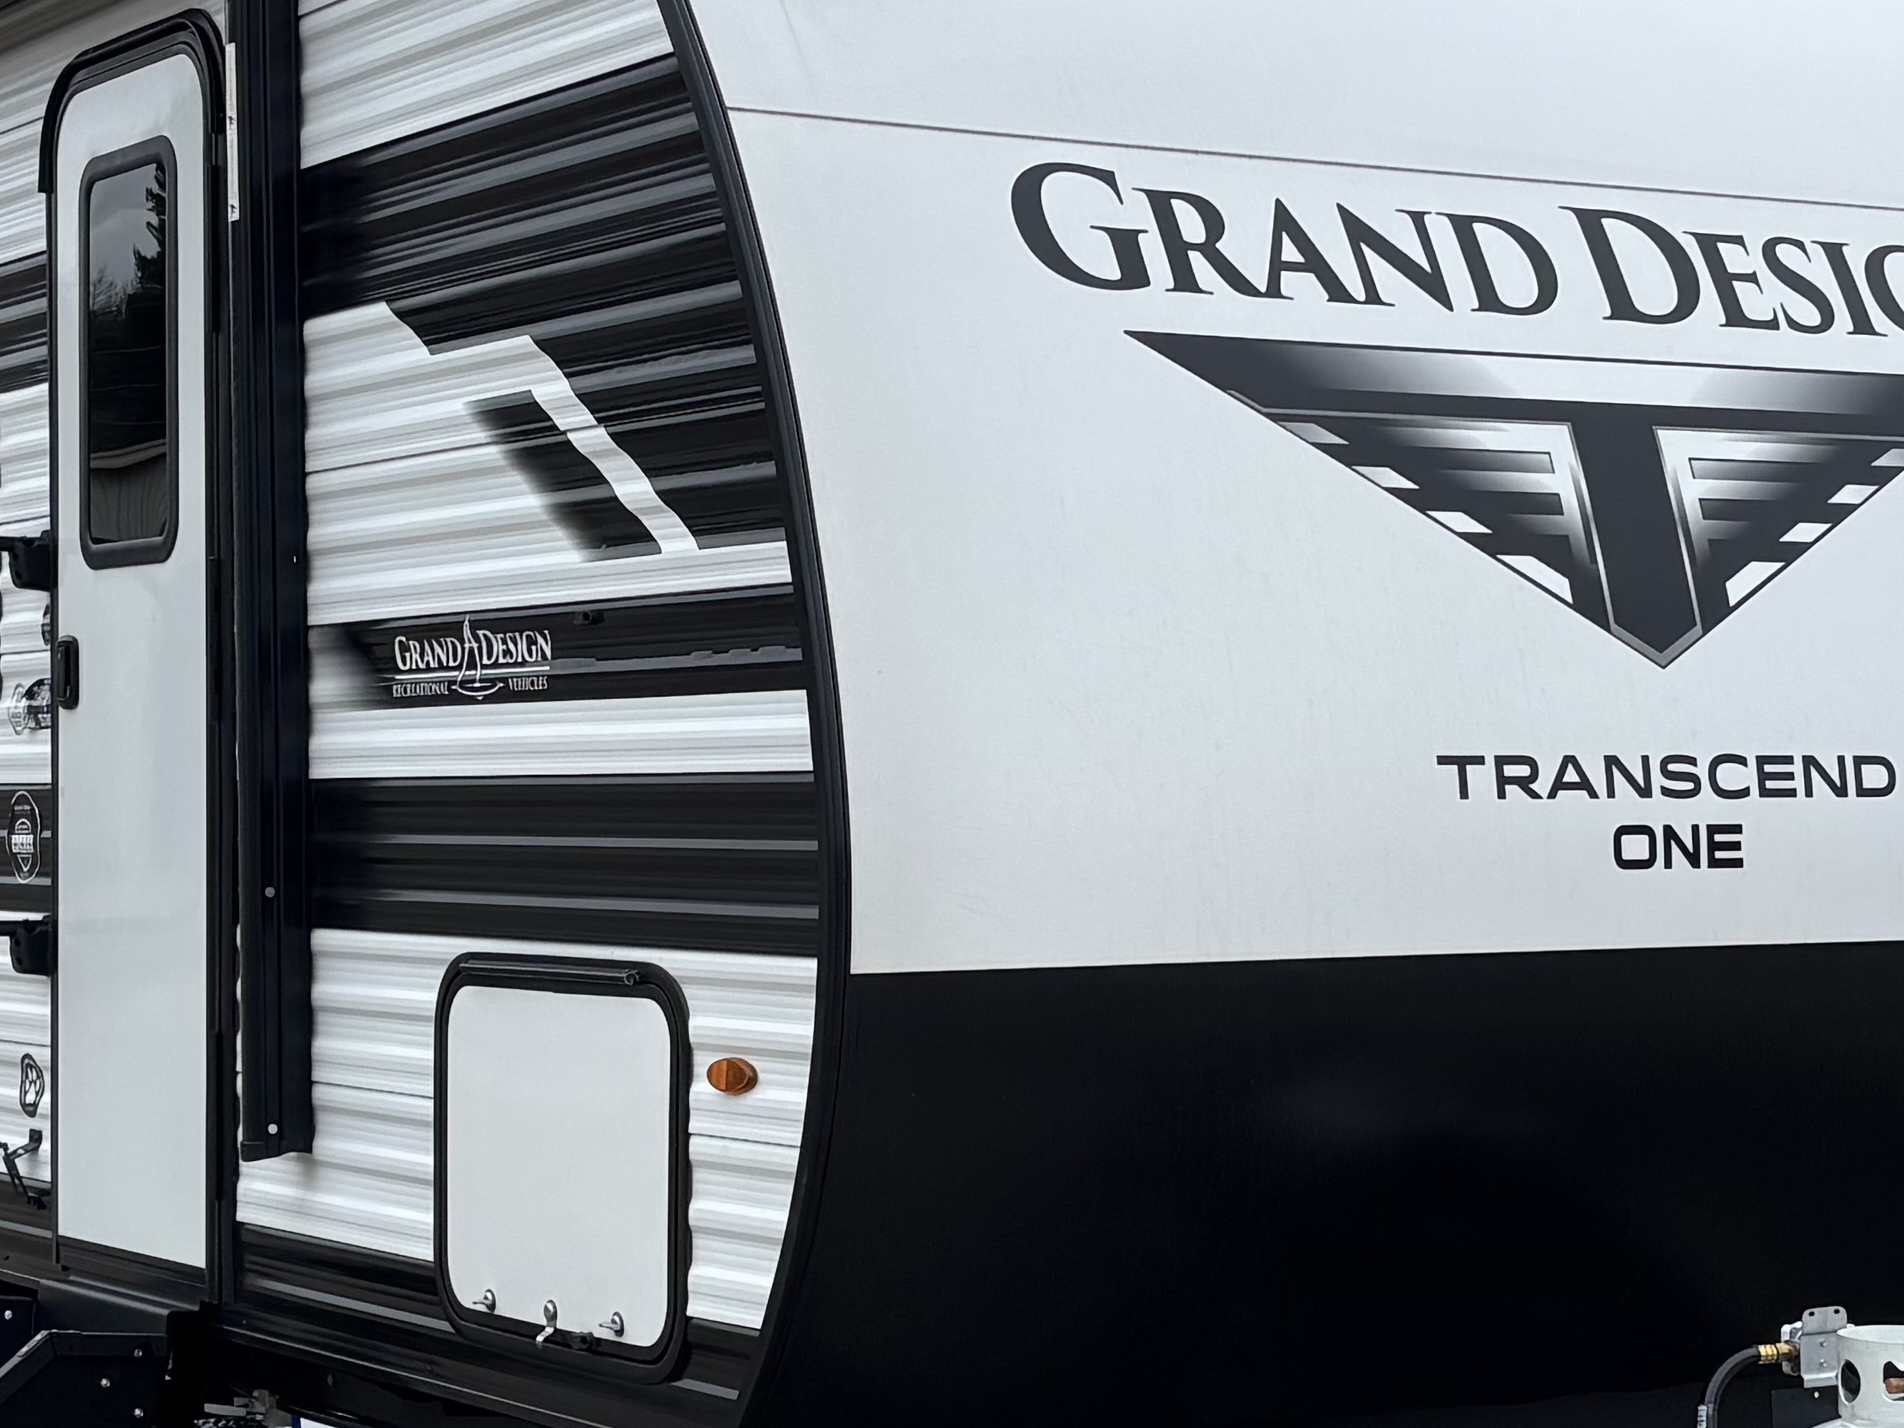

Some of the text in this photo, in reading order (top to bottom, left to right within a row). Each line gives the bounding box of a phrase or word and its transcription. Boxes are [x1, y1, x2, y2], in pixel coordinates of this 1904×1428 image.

[1010, 161, 1560, 315] GRAND
[394, 629, 552, 671] GRAND DESIGN
[1436, 753, 1898, 801] TRANSCEND
[1612, 823, 1745, 870] ONE
